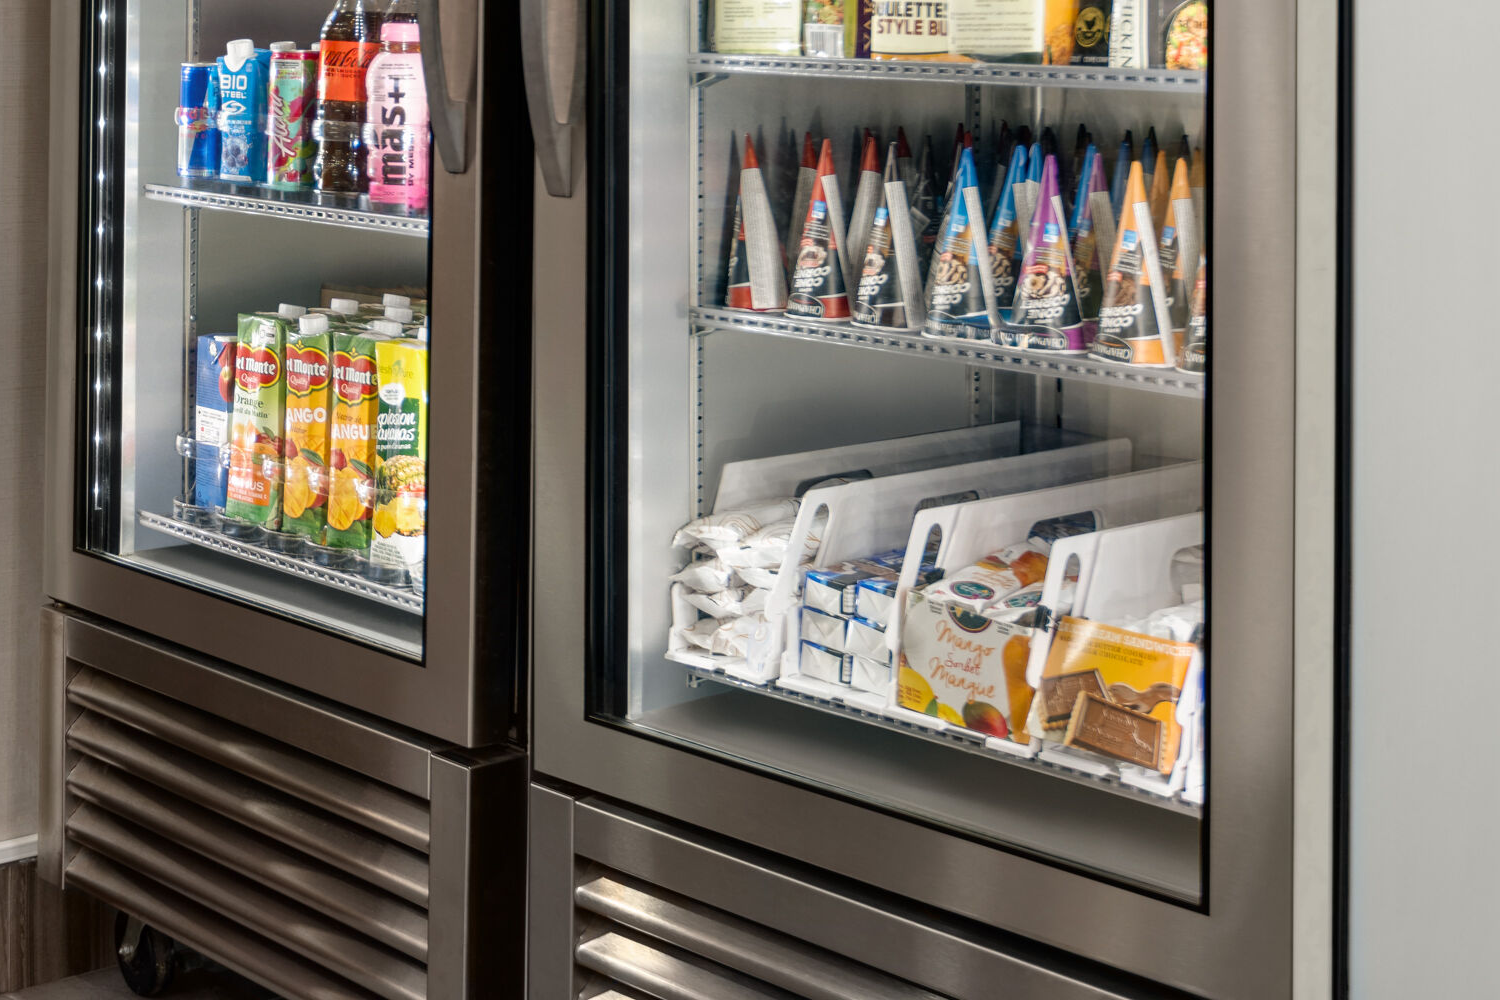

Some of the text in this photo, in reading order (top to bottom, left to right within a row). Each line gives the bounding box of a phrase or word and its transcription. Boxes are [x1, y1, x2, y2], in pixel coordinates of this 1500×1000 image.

[871, 2, 947, 18] BOULETTE
[877, 18, 923, 36] STYLE
[220, 73, 249, 91] BIO
[220, 89, 248, 99] STEEL
[794, 277, 824, 288] CONE
[858, 273, 889, 286] CORN
[932, 282, 971, 294] CORNE
[857, 285, 880, 296] CON
[1021, 294, 1071, 309] CORNET
[1027, 307, 1061, 320] CONE
[1100, 303, 1144, 318] CORNE
[1101, 316, 1135, 330] CONE
[245, 357, 276, 375] Monte
[293, 358, 327, 377] Monte
[345, 366, 378, 386] Monte
[286, 407, 327, 424] ANGO
[378, 408, 416, 428] plosion
[331, 423, 378, 441] ANGUE
[936, 619, 996, 659] Mango
[944, 653, 981, 676] Sorbet
[930, 656, 996, 705] Mangue
